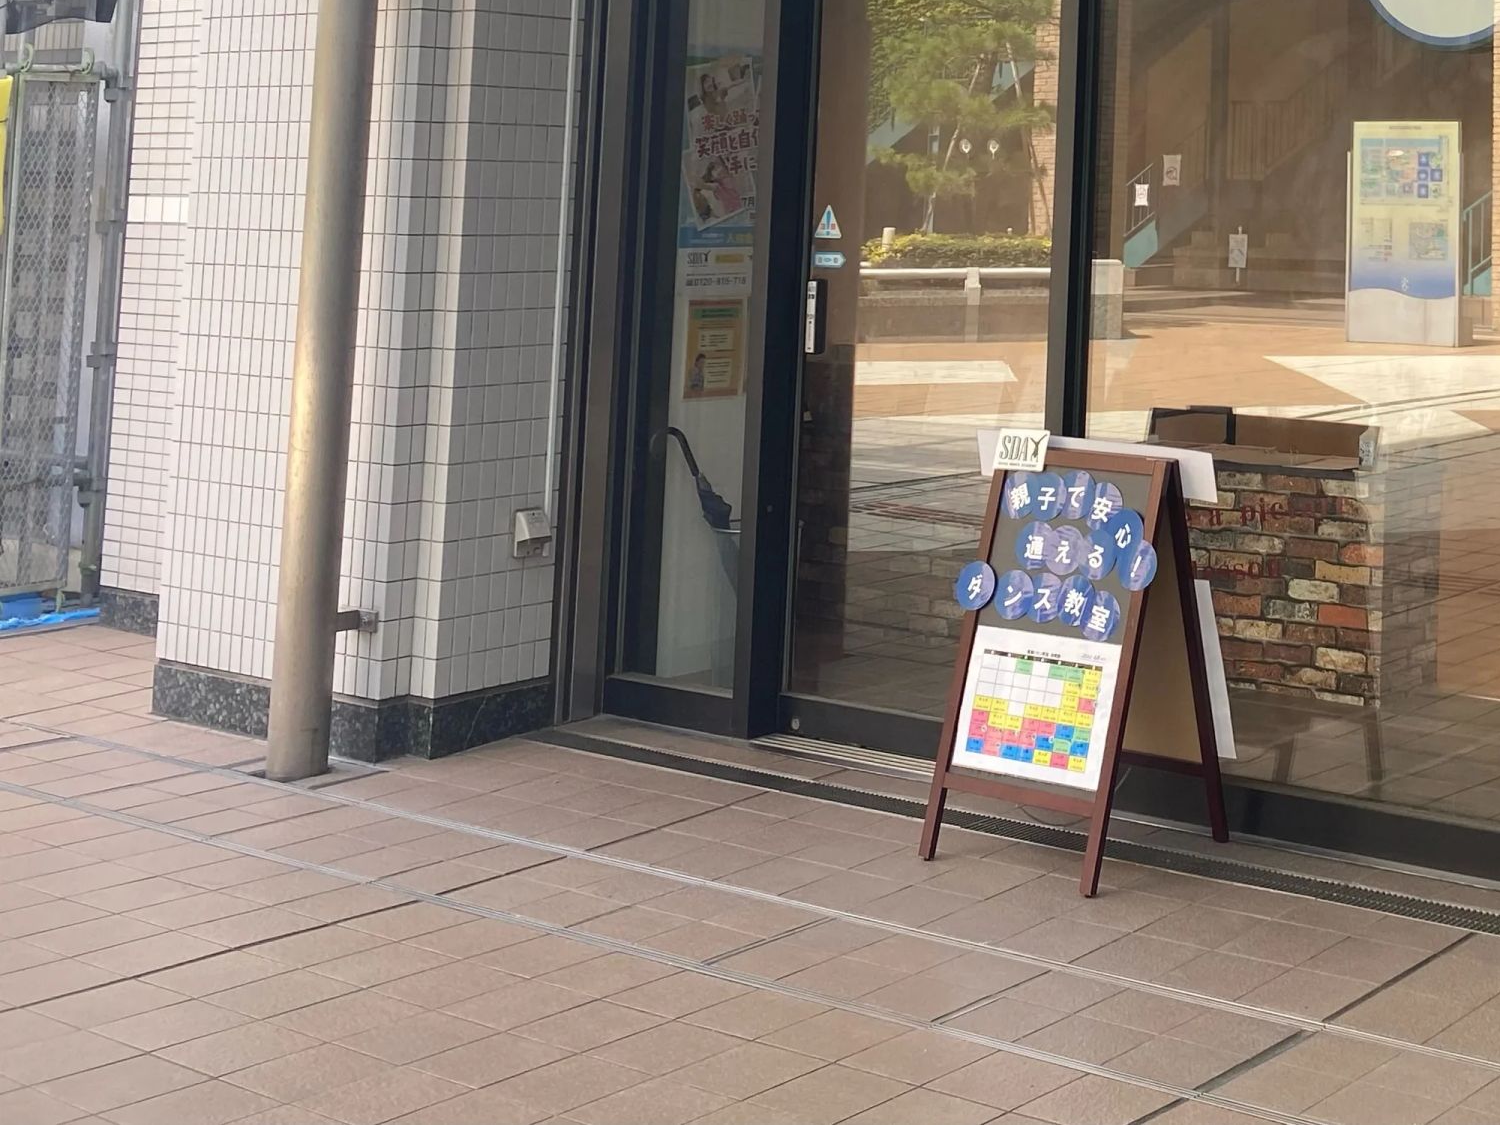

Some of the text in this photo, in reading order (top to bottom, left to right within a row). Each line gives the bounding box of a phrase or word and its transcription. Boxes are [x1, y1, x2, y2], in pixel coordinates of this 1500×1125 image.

[1023, 535, 1105, 569] 通える
[967, 574, 1111, 633] ダンス教室
